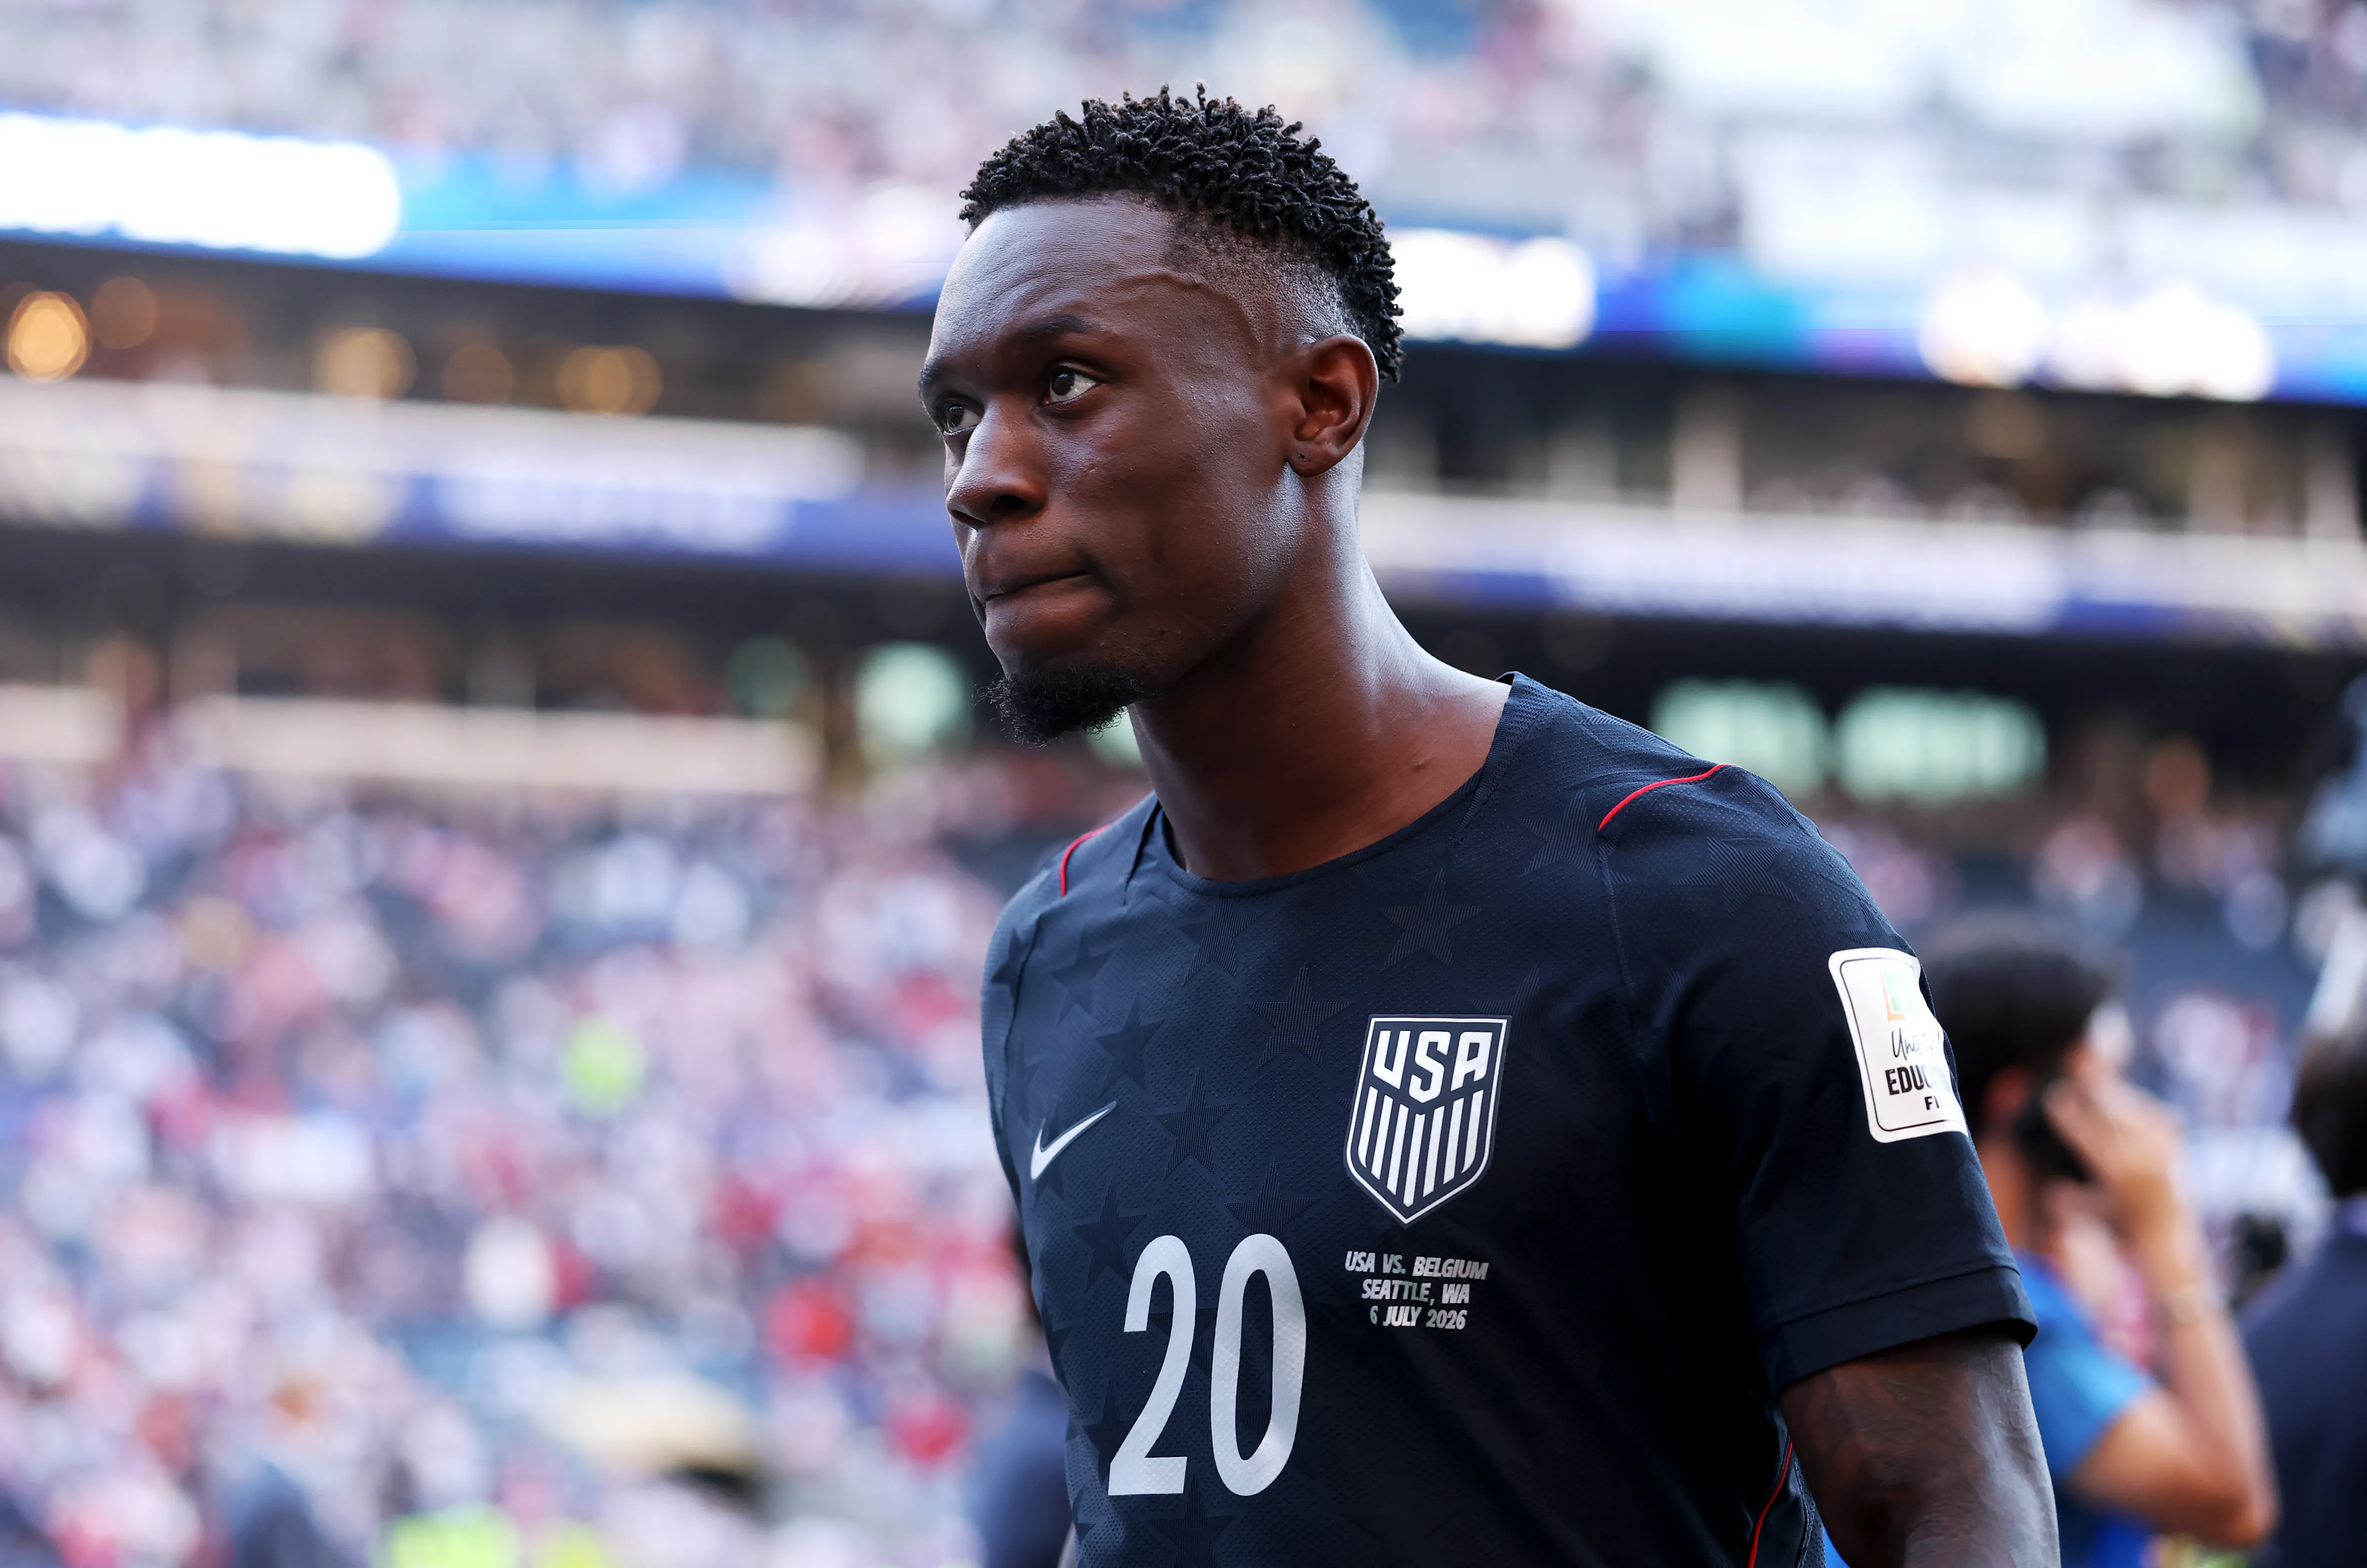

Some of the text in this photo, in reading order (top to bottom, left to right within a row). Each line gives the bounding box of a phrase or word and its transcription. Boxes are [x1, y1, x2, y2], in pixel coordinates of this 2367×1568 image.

[1372, 1030, 1493, 1103] USA
[1345, 1251, 1489, 1280] USA VS. BELGIUM
[1361, 1279, 1470, 1306] SEATTLE, WA
[1370, 1305, 1468, 1330] 6 JULY 2026
[1108, 1233, 1306, 1496] 20
